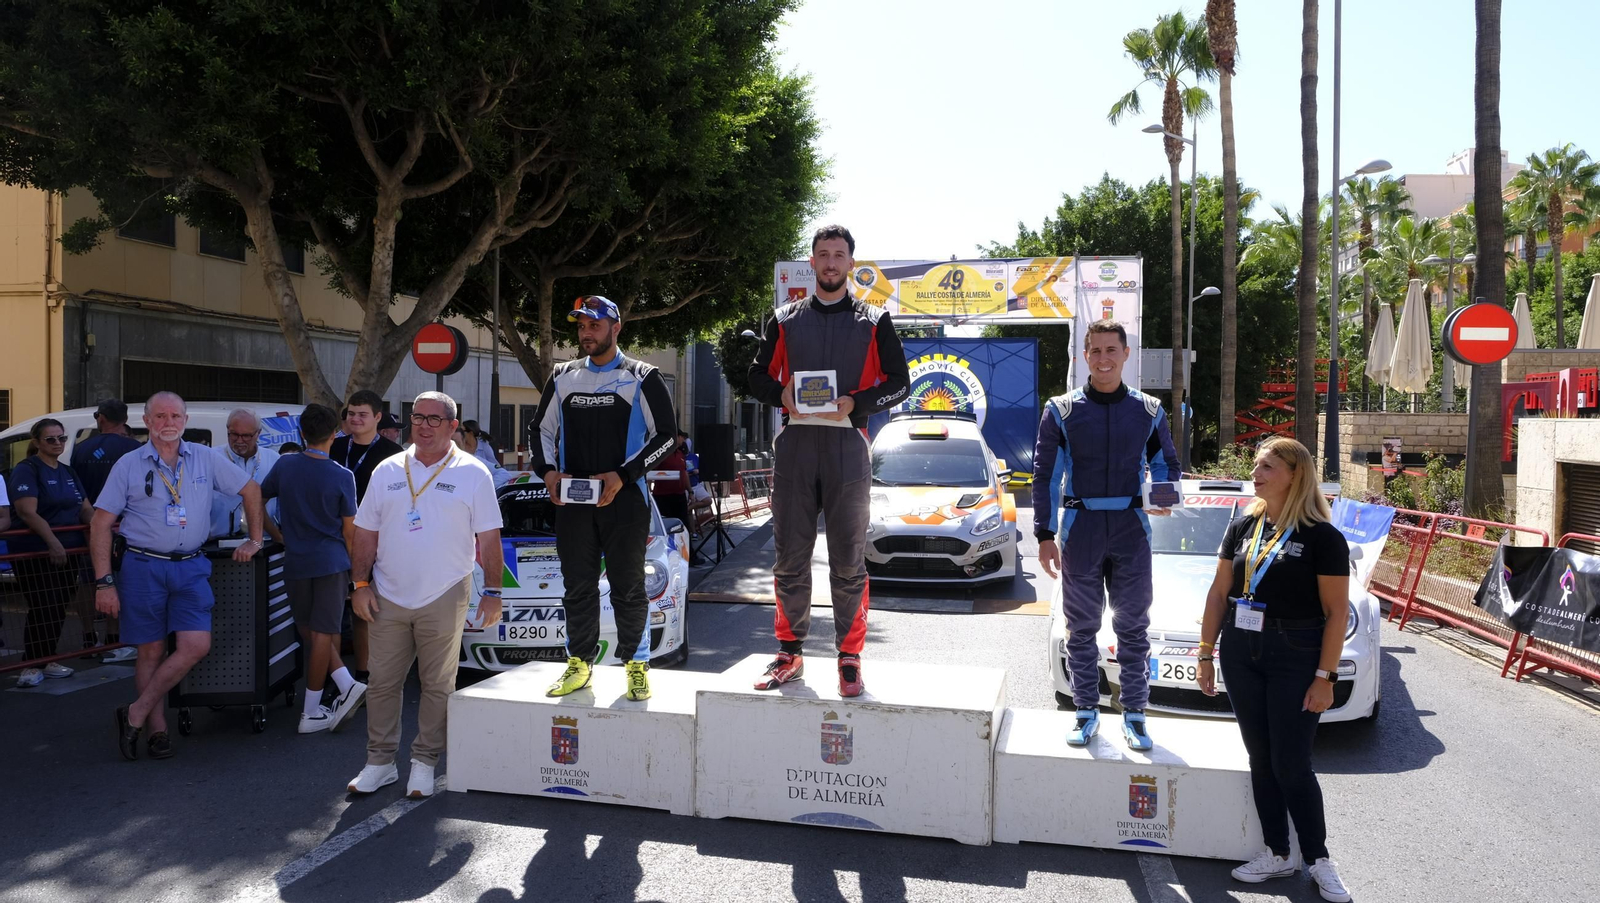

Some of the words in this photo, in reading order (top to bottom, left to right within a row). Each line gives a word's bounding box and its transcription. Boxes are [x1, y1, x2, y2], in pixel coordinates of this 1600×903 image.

[938, 269, 965, 290] 49
[916, 291, 937, 299] RALLYE
[937, 291, 956, 299] COSTA
[956, 291, 964, 299] DE
[965, 289, 991, 299] ALMERÍA
[960, 371, 981, 397] CLUB
[570, 394, 615, 405] ASTARS
[644, 437, 675, 467] ASTARS
[517, 487, 549, 496] And
[509, 626, 547, 639] 8290
[556, 625, 565, 638] K
[1162, 647, 1188, 655] PRO
[1162, 663, 1197, 681] 269
[540, 766, 590, 778] DIPUTACIÓN
[541, 776, 552, 784] DE
[553, 776, 588, 787] ALMERÍA
[788, 786, 808, 800] DE
[813, 788, 885, 807] ALMERÍA
[1116, 821, 1168, 831] DIPUTACIÓN
[1118, 829, 1129, 837] DE
[1131, 830, 1167, 839] ALMERÍA
